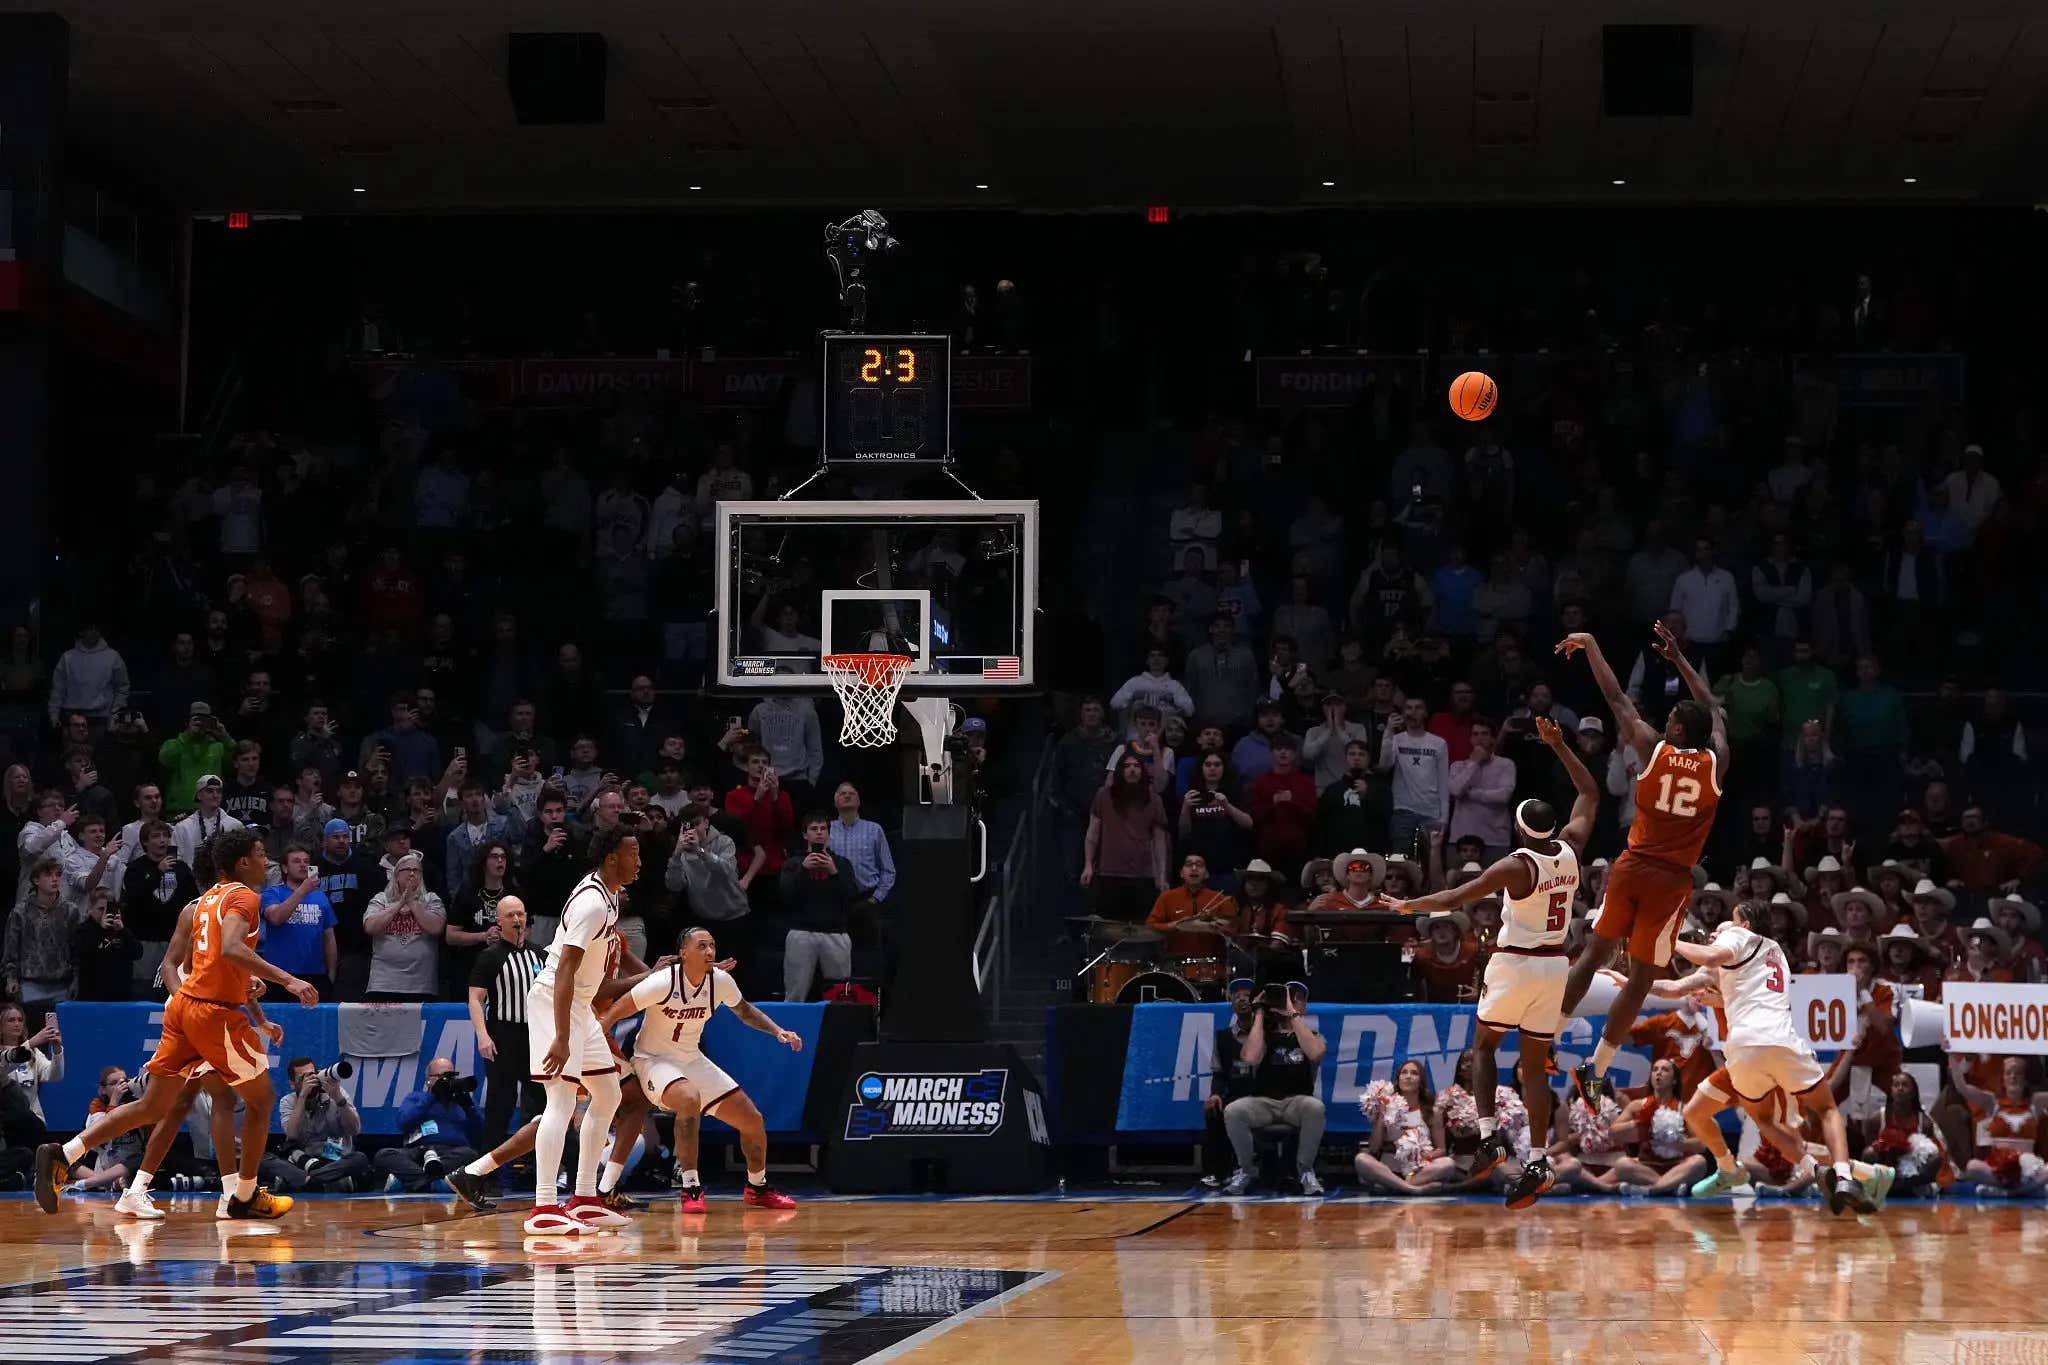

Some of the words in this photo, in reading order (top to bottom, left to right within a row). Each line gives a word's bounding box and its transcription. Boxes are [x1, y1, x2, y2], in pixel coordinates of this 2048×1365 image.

[855, 452, 916, 460] DAKTRONICS
[1668, 755, 1701, 773] MARK
[225, 795, 268, 813] XAVIER
[1654, 773, 1702, 817] 12
[1546, 891, 1568, 932] 5
[198, 911, 210, 952] 3
[1766, 960, 1784, 993] 3
[661, 1006, 678, 1019] NC
[678, 1006, 707, 1020] STATE
[1808, 998, 1847, 1043] GO
[671, 1022, 685, 1042] 1
[882, 1077, 964, 1101] MARCH
[891, 1101, 1002, 1126] MADNESS
